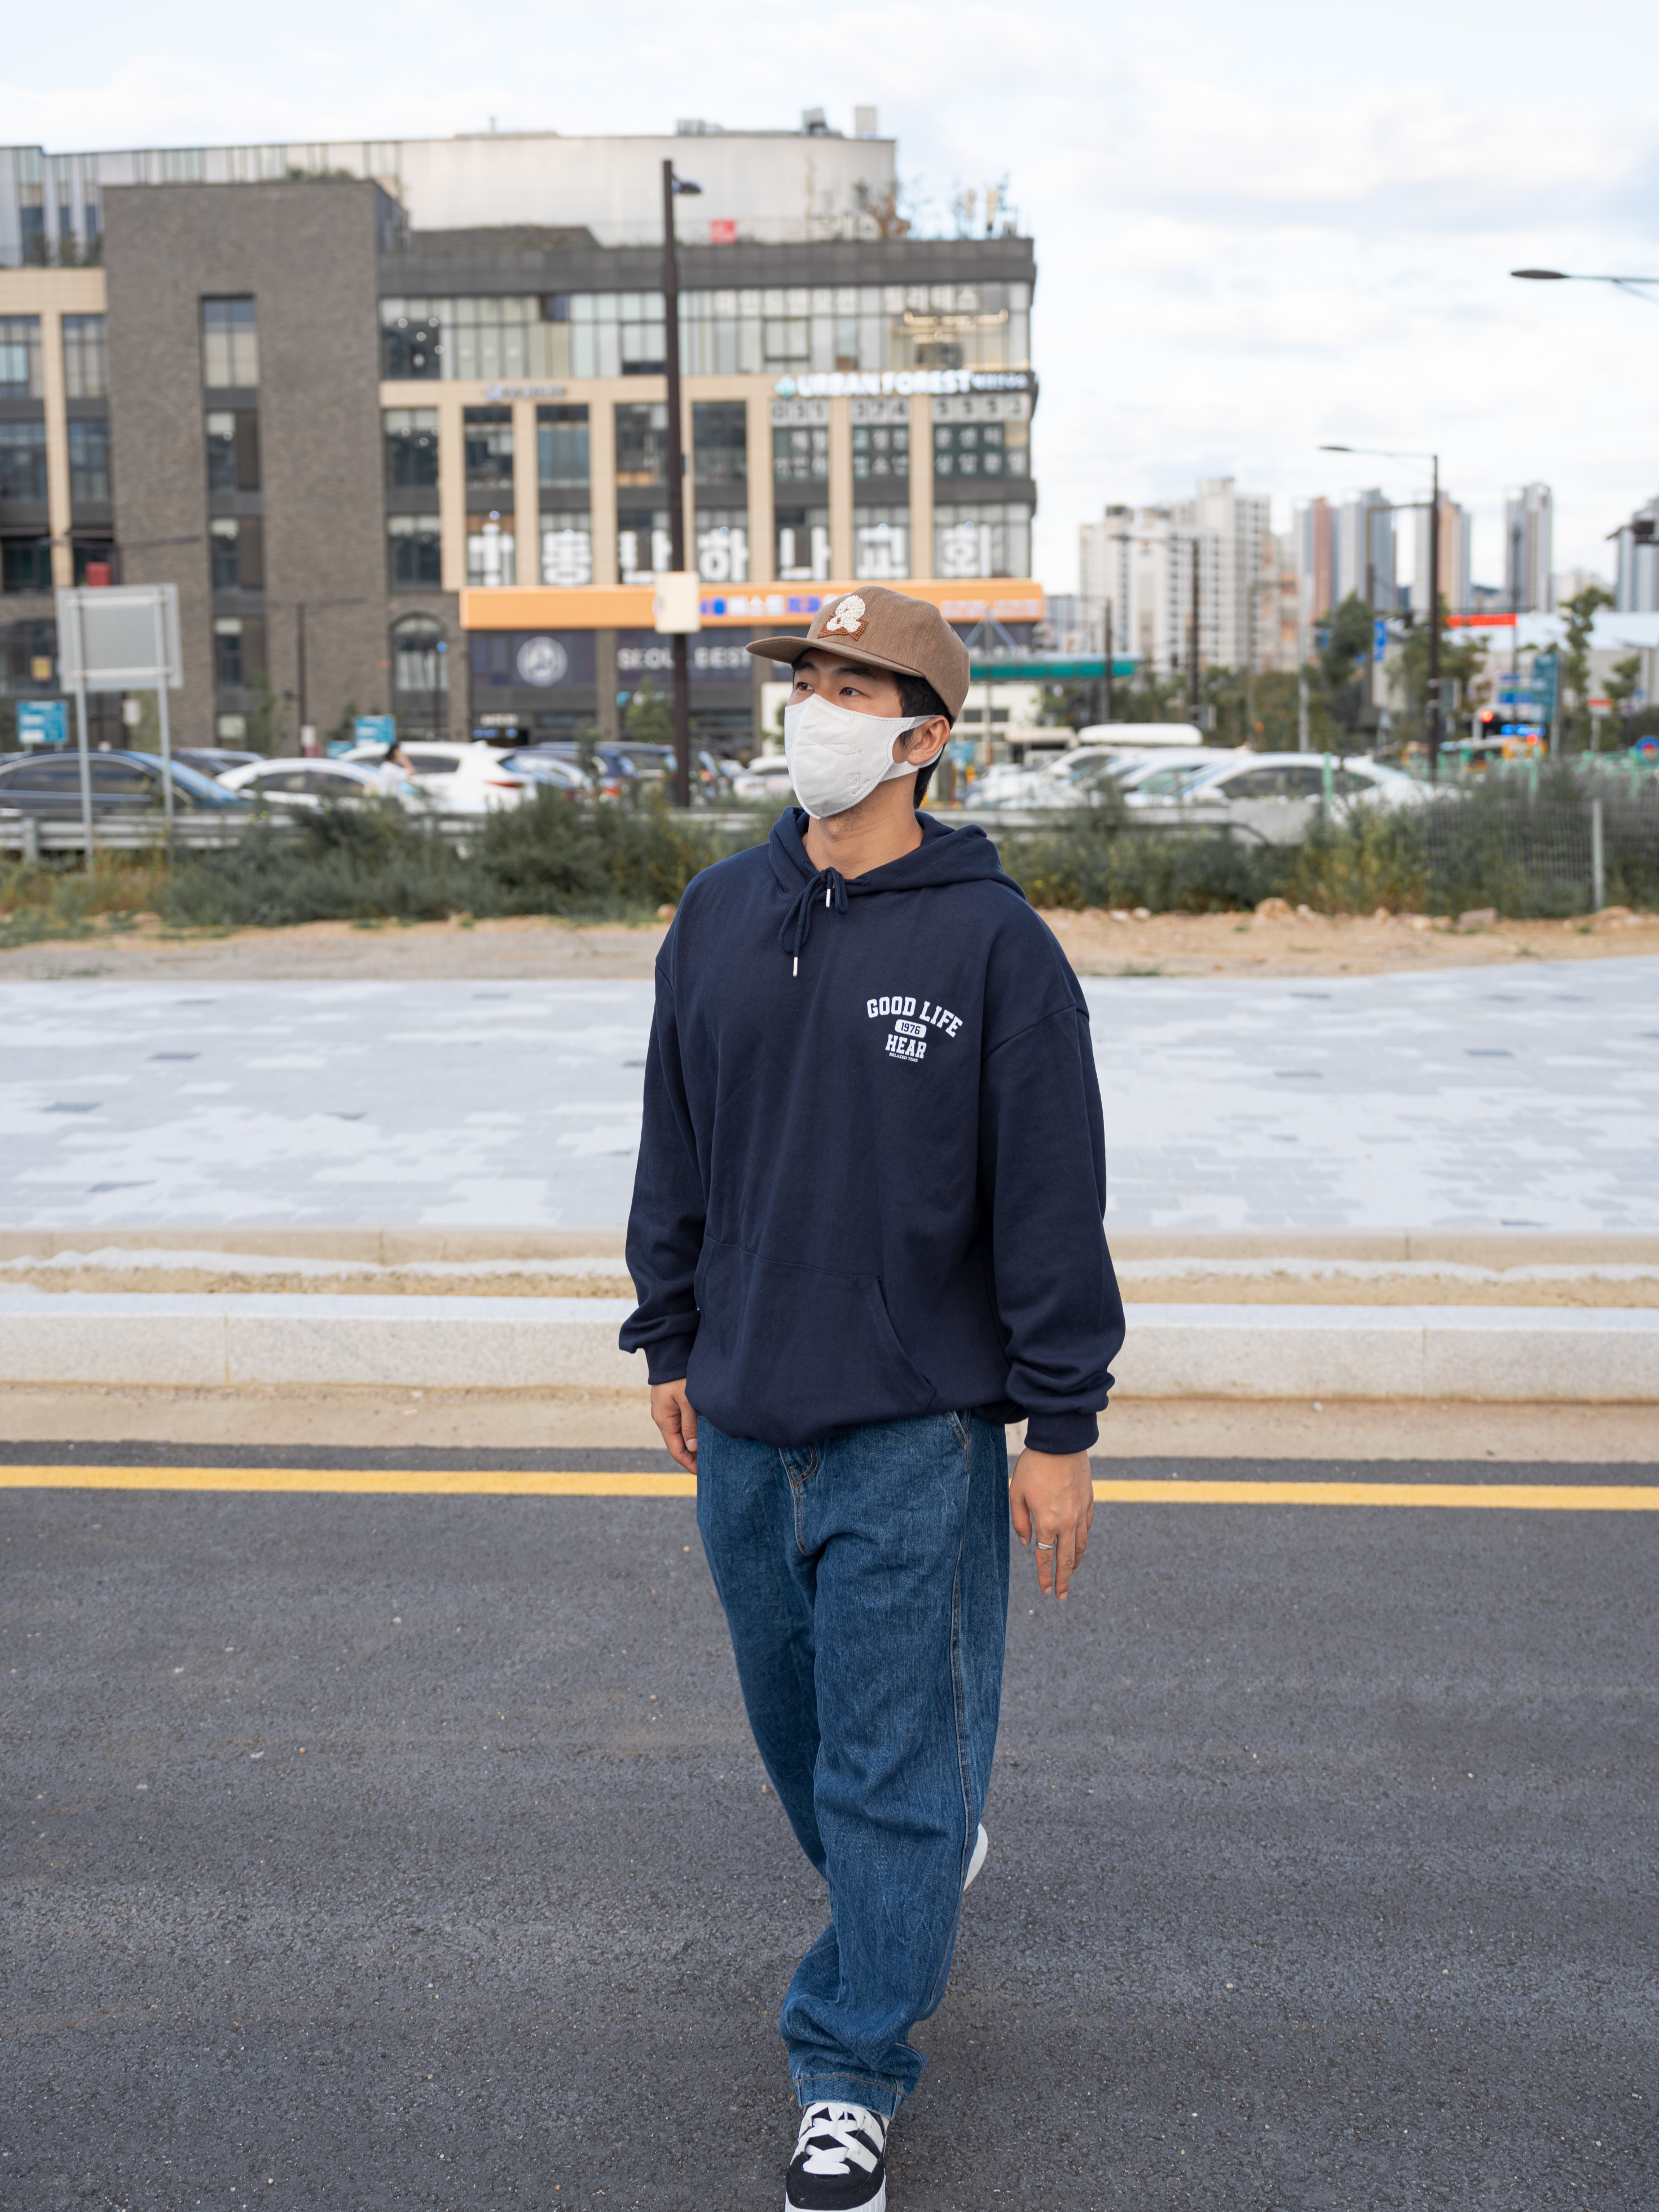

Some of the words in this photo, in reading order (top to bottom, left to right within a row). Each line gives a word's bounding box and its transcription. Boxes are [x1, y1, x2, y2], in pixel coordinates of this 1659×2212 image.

[797, 372, 881, 397] URBAN
[881, 369, 973, 395] FOREST
[866, 996, 917, 1018] GOOD
[919, 1001, 963, 1038] LIFE
[901, 1022, 921, 1035] 1976
[885, 1034, 927, 1059] HEAR
[889, 1052, 908, 1060] RELAXED
